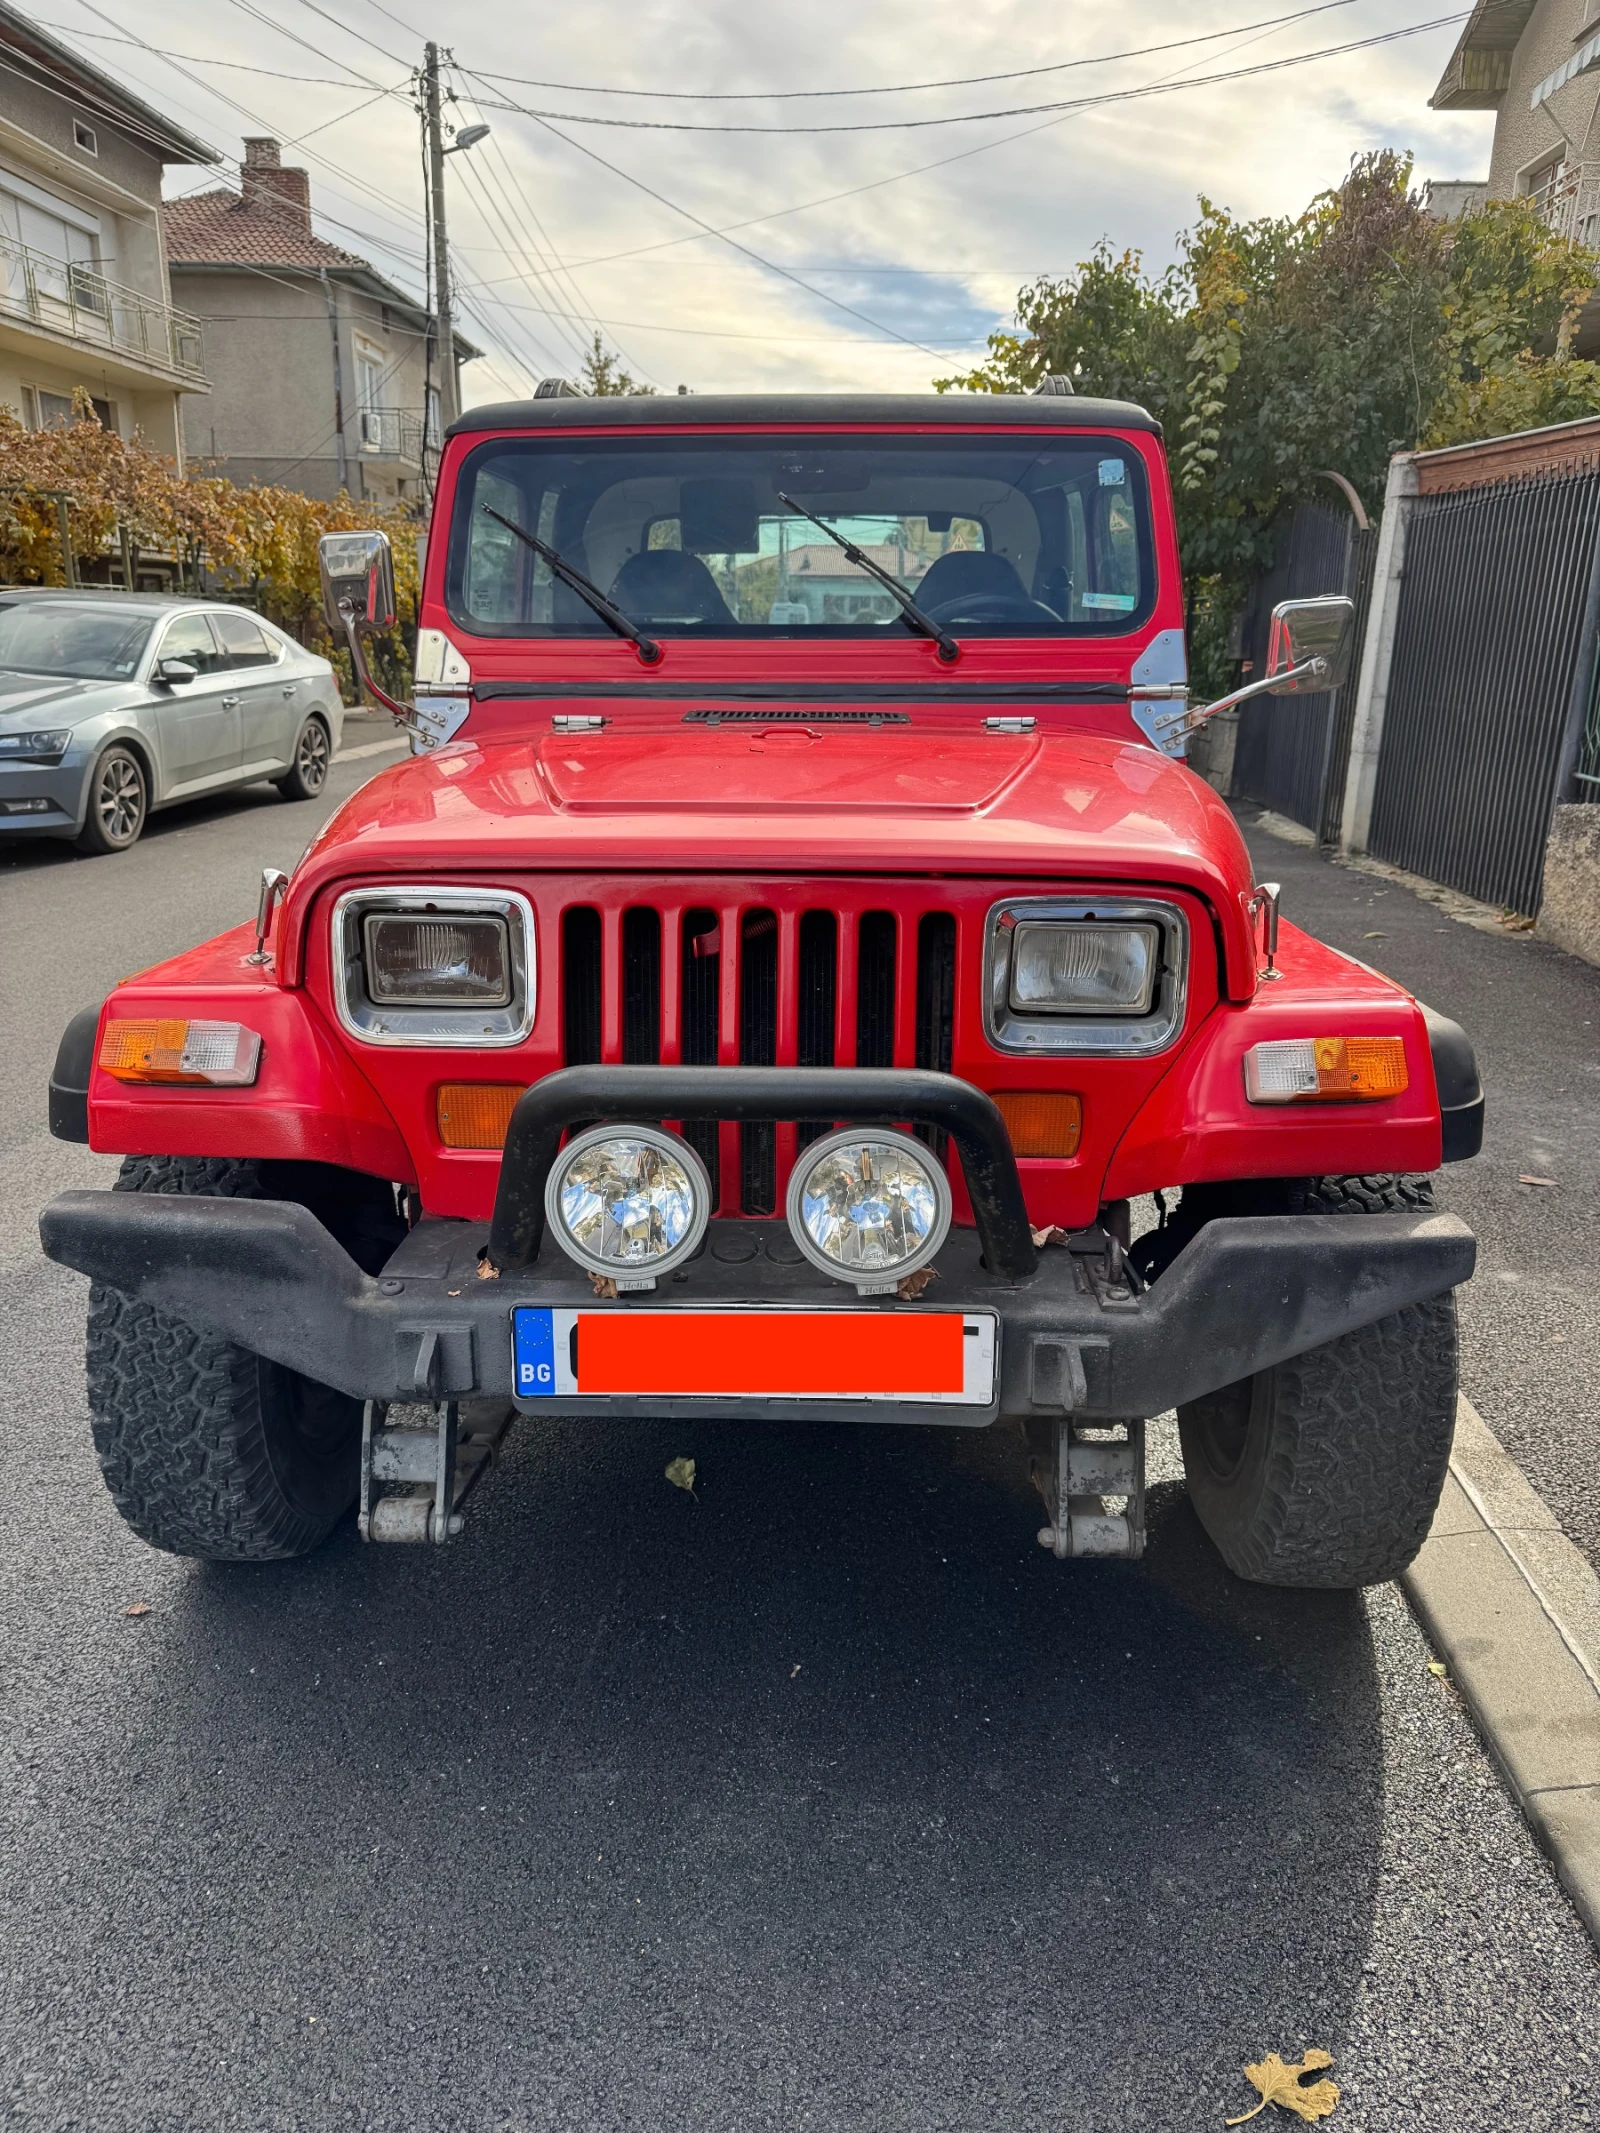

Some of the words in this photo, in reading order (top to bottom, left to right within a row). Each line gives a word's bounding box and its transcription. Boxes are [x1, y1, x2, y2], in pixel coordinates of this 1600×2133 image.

[624, 1282, 649, 1290] Hella
[865, 1286, 891, 1295] Hella
[521, 1363, 551, 1383] BG
